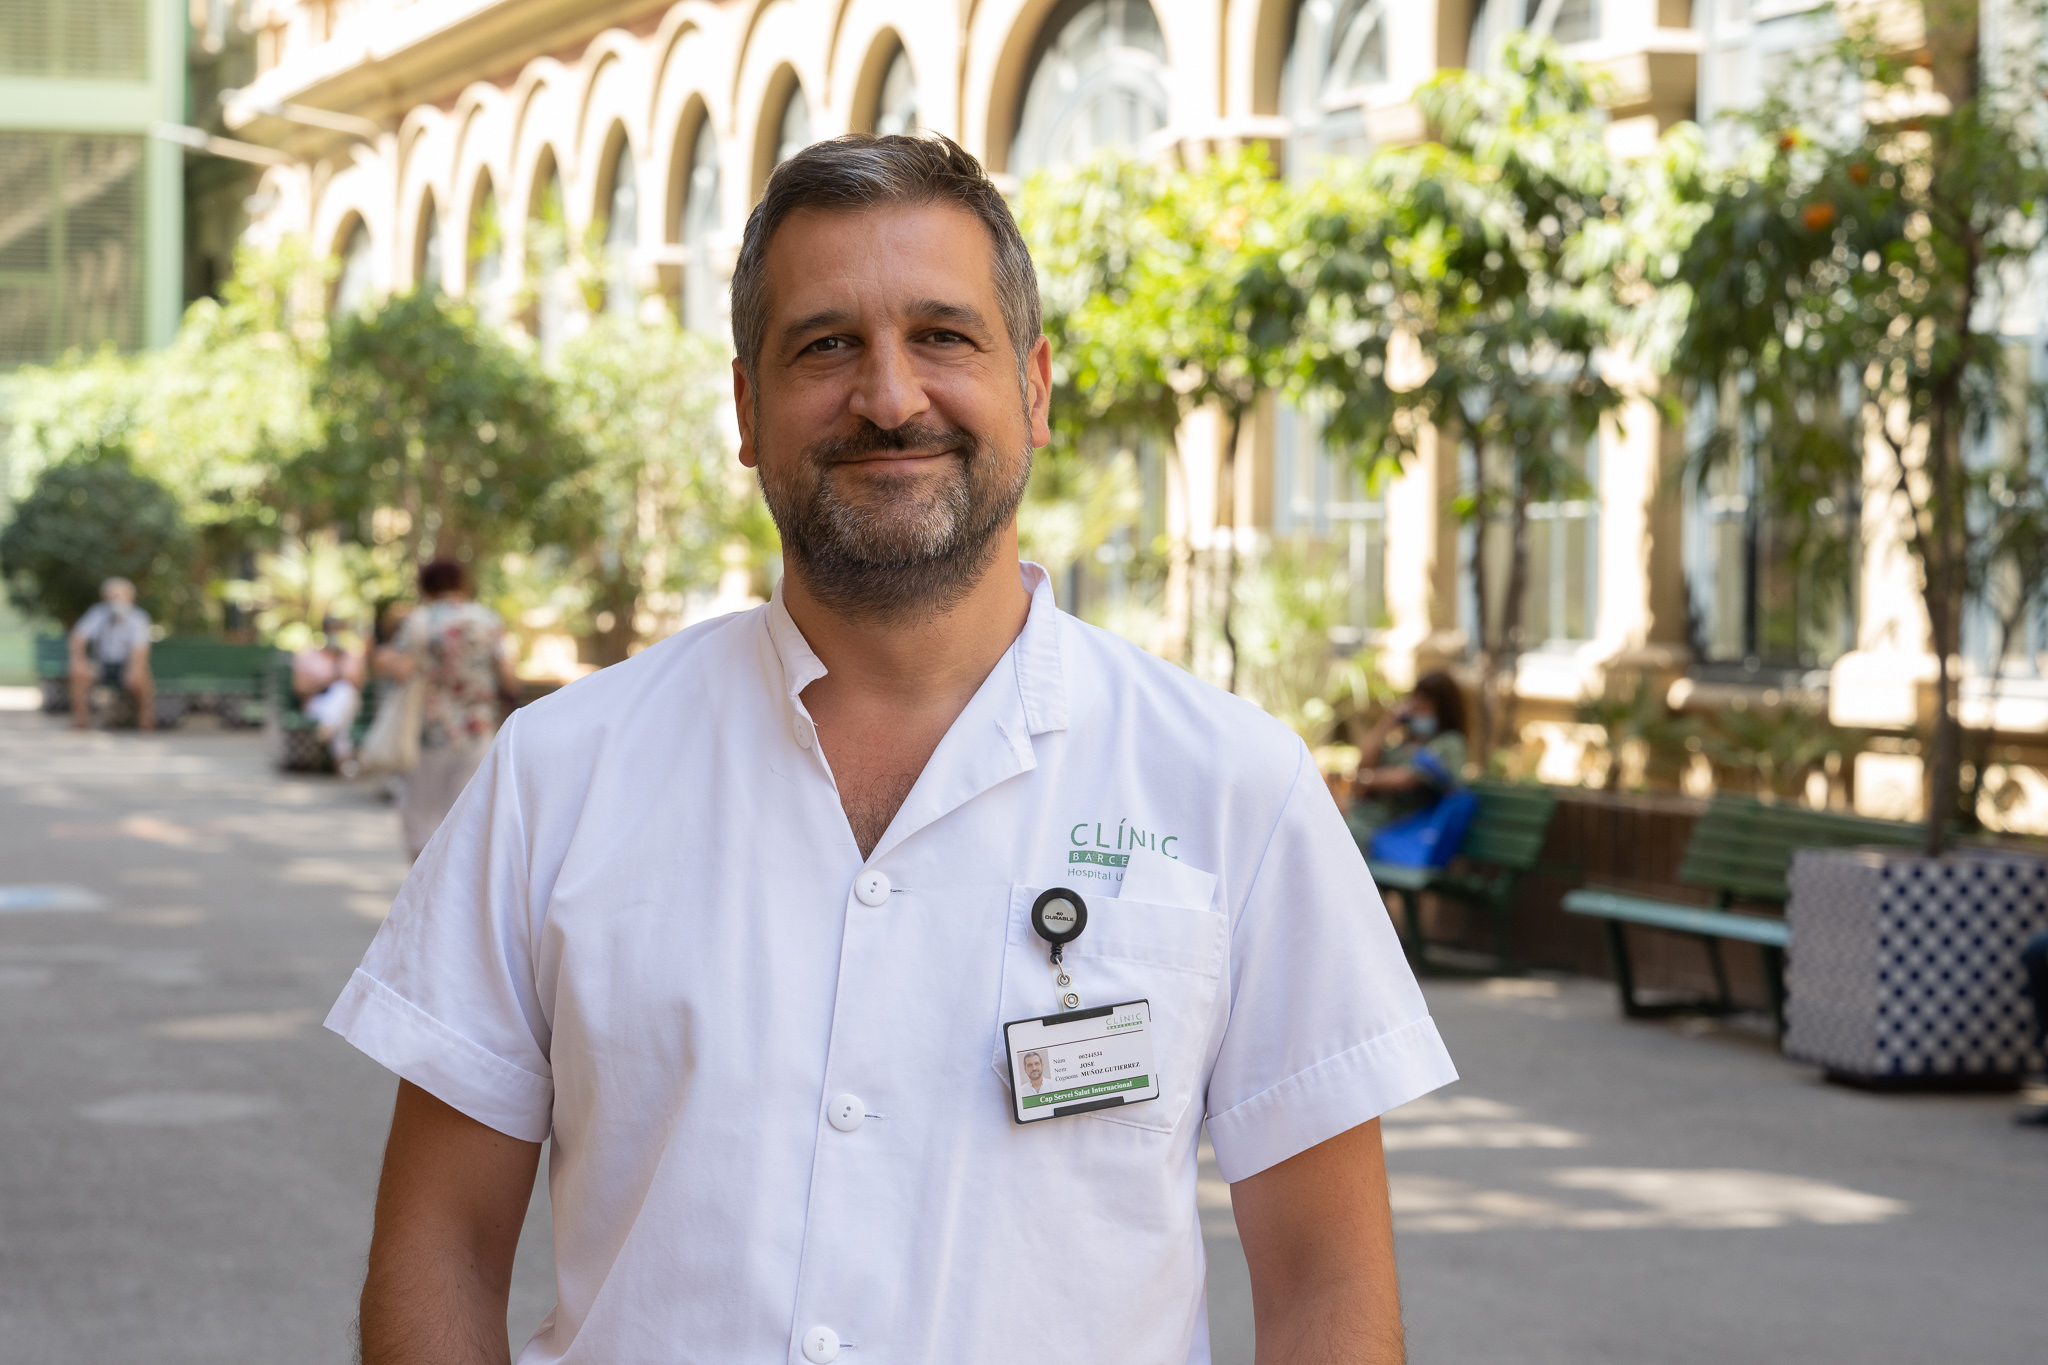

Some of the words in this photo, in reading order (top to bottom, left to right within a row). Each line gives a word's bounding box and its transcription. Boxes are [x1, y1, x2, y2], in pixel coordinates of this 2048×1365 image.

[1070, 818, 1178, 859] CLÍNIC
[1072, 852, 1129, 866] BARCE
[1067, 868, 1111, 881] Hospital
[1044, 914, 1074, 922] DURABLE
[1081, 1068, 1104, 1077] MUÑOZ
[1104, 1061, 1141, 1073] GUTIERREZ
[1039, 1095, 1053, 1103] Cap
[1053, 1091, 1074, 1101] Servei
[1074, 1088, 1090, 1097] Salut
[1091, 1080, 1133, 1094] Internacional
